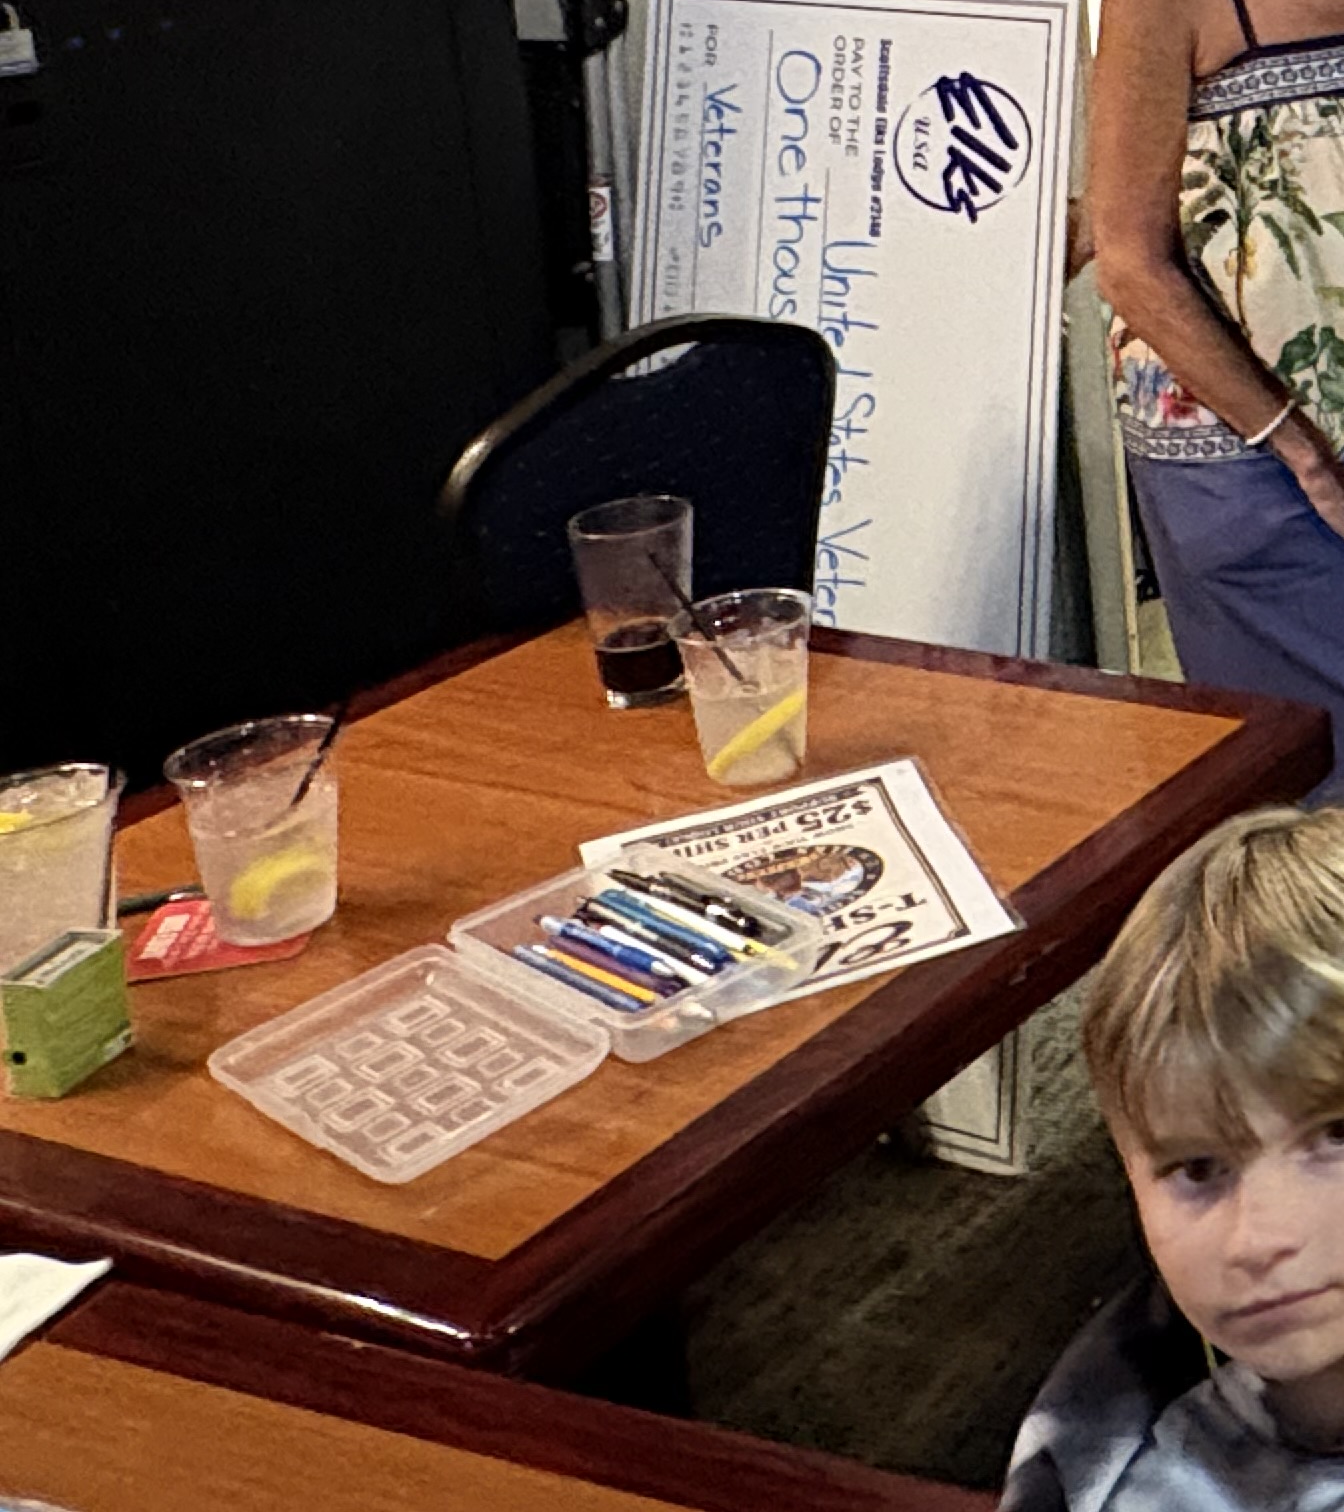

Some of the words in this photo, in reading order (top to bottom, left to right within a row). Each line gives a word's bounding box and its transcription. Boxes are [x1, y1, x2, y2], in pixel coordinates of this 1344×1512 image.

[704, 24, 718, 67] FOR
[850, 36, 865, 79] PAY
[829, 34, 847, 111] ORDER
[877, 38, 893, 114] Scottsdale
[776, 50, 823, 177] One
[848, 83, 862, 111] TO
[828, 116, 842, 145] OF
[844, 116, 861, 157] THE
[874, 117, 888, 145] Elks
[936, 71, 1019, 224] Elks
[700, 83, 743, 248] Veterans
[871, 150, 886, 192] Lodge
[815, 518, 874, 626] Veter
[736, 820, 789, 844] PER
[796, 799, 874, 833] $25
